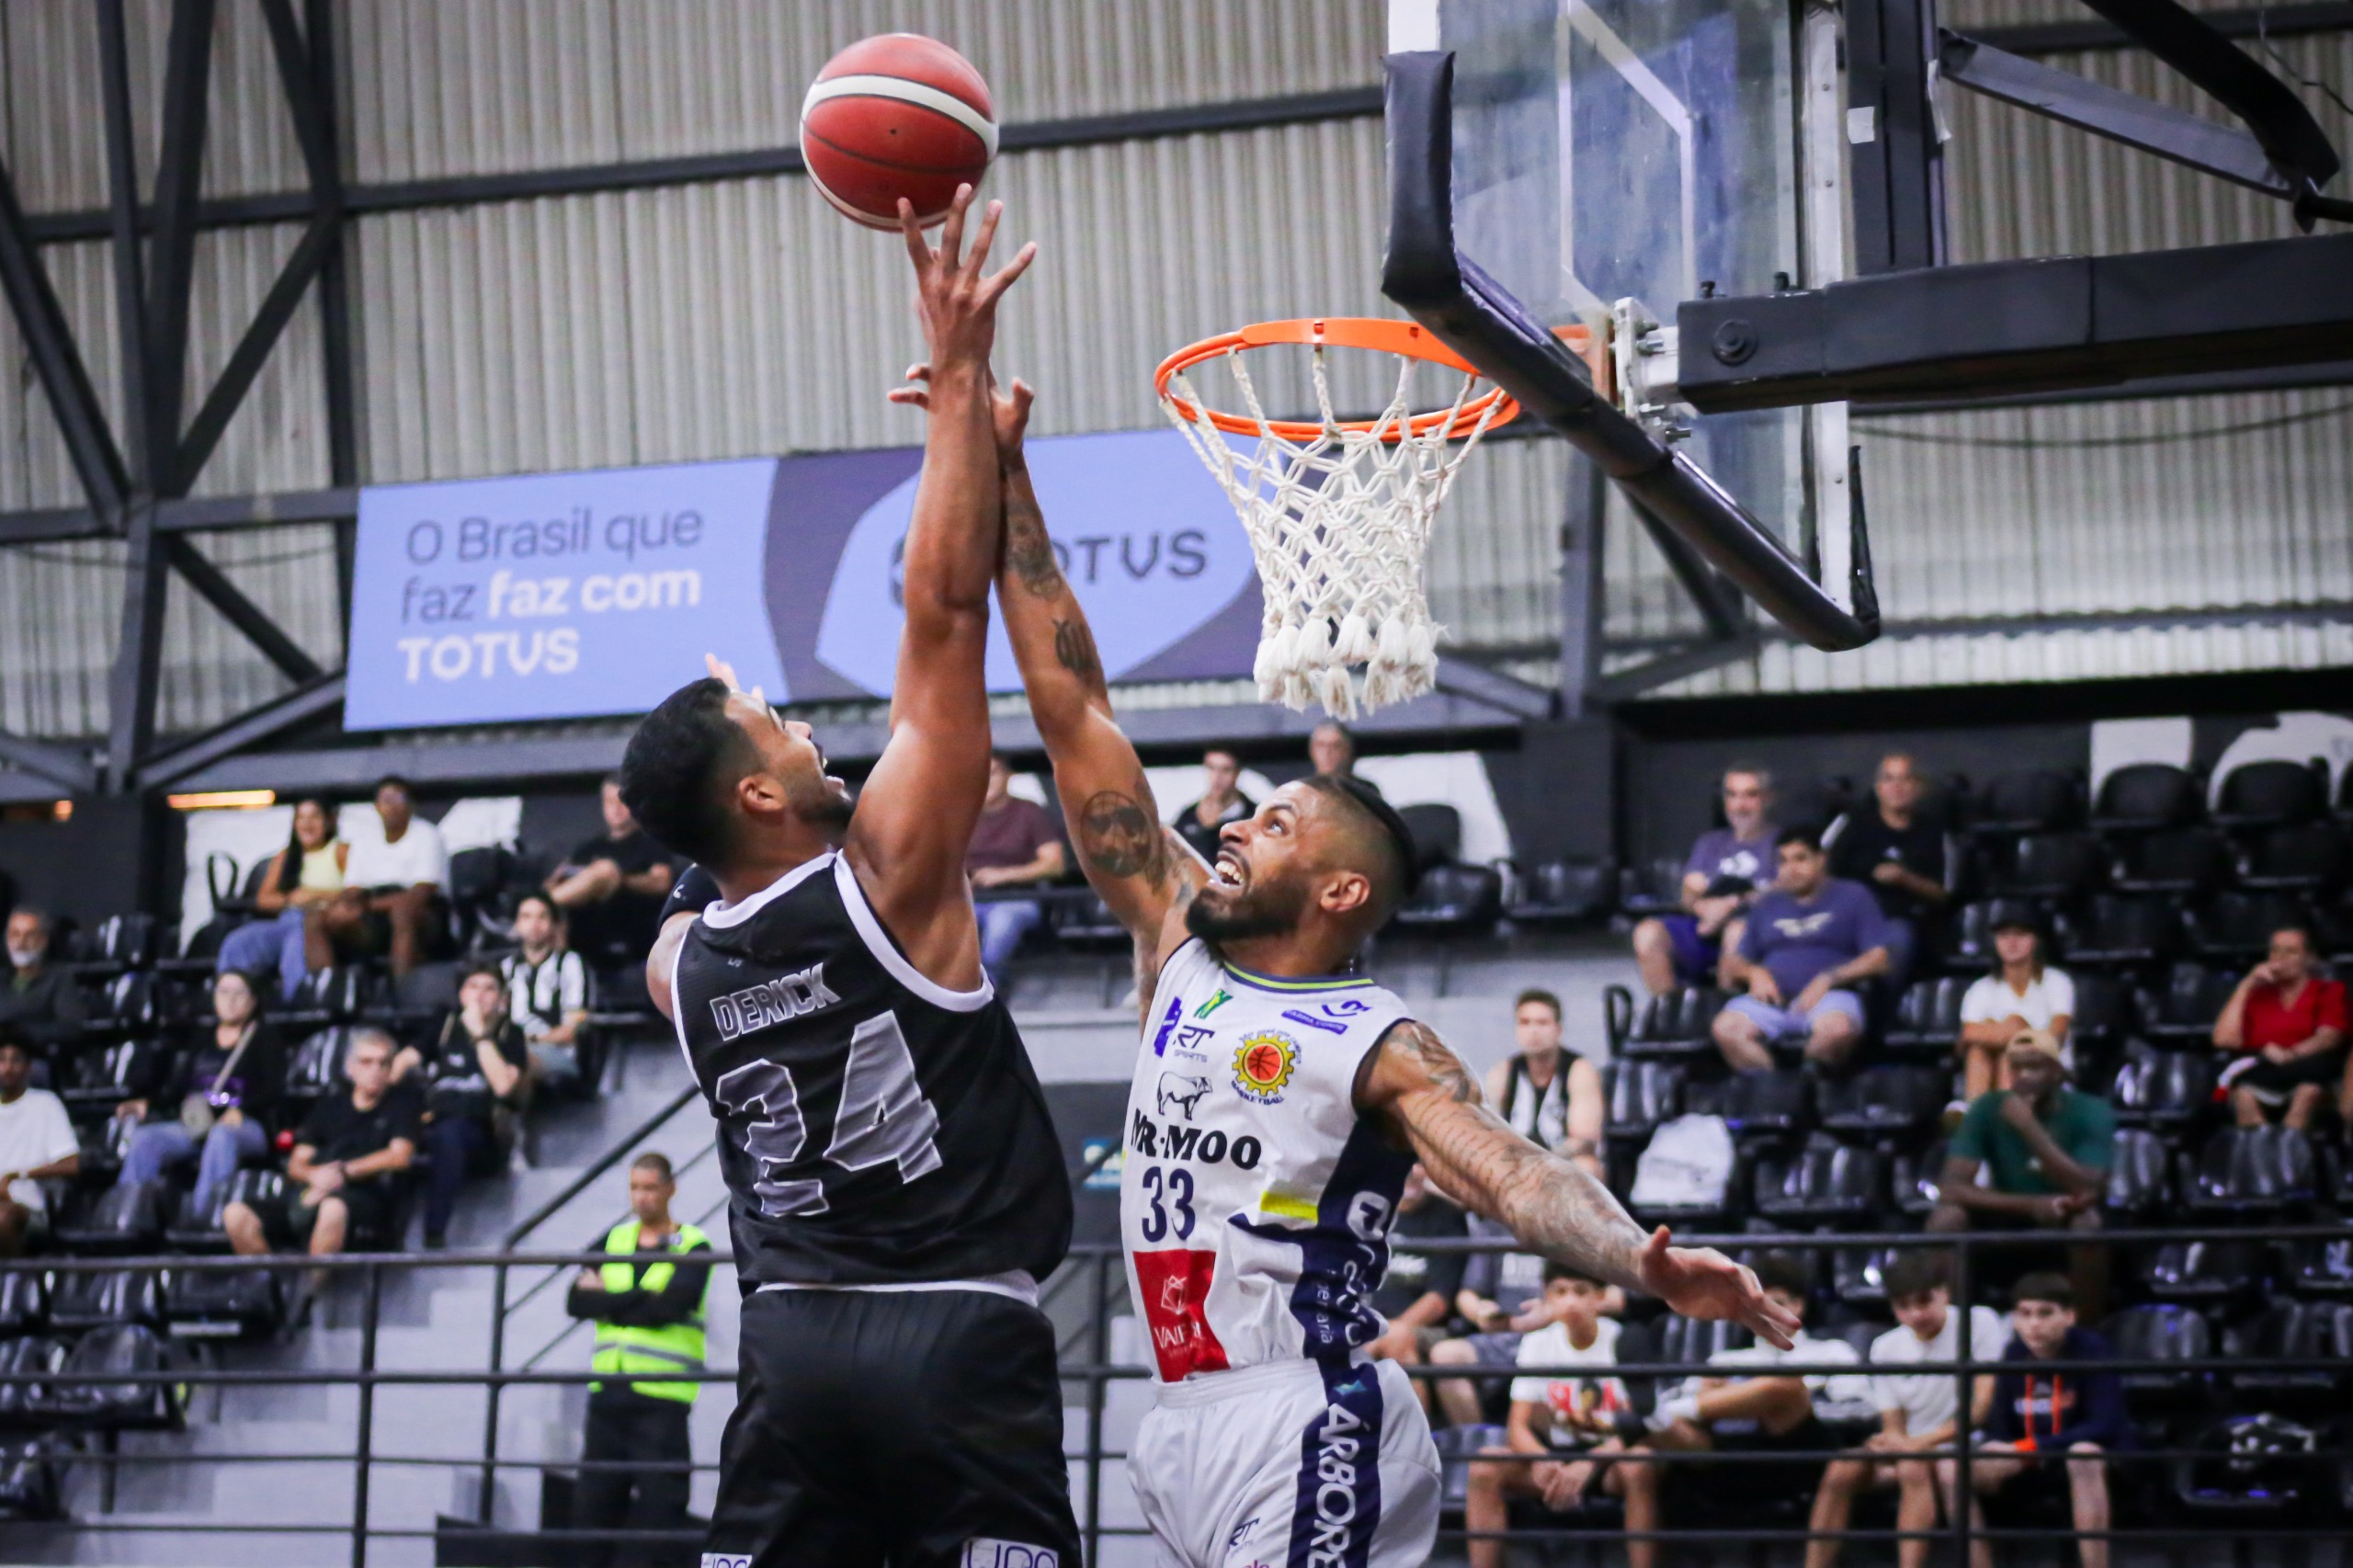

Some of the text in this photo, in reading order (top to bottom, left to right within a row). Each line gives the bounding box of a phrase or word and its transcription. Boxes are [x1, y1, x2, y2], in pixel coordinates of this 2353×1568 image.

[407, 506, 703, 565] O Brasil que
[1055, 528, 1208, 583] TVS
[402, 568, 700, 623] faz faz com
[710, 962, 841, 1041] DERICK
[716, 1009, 943, 1217] 24
[1142, 1166, 1195, 1242] 33
